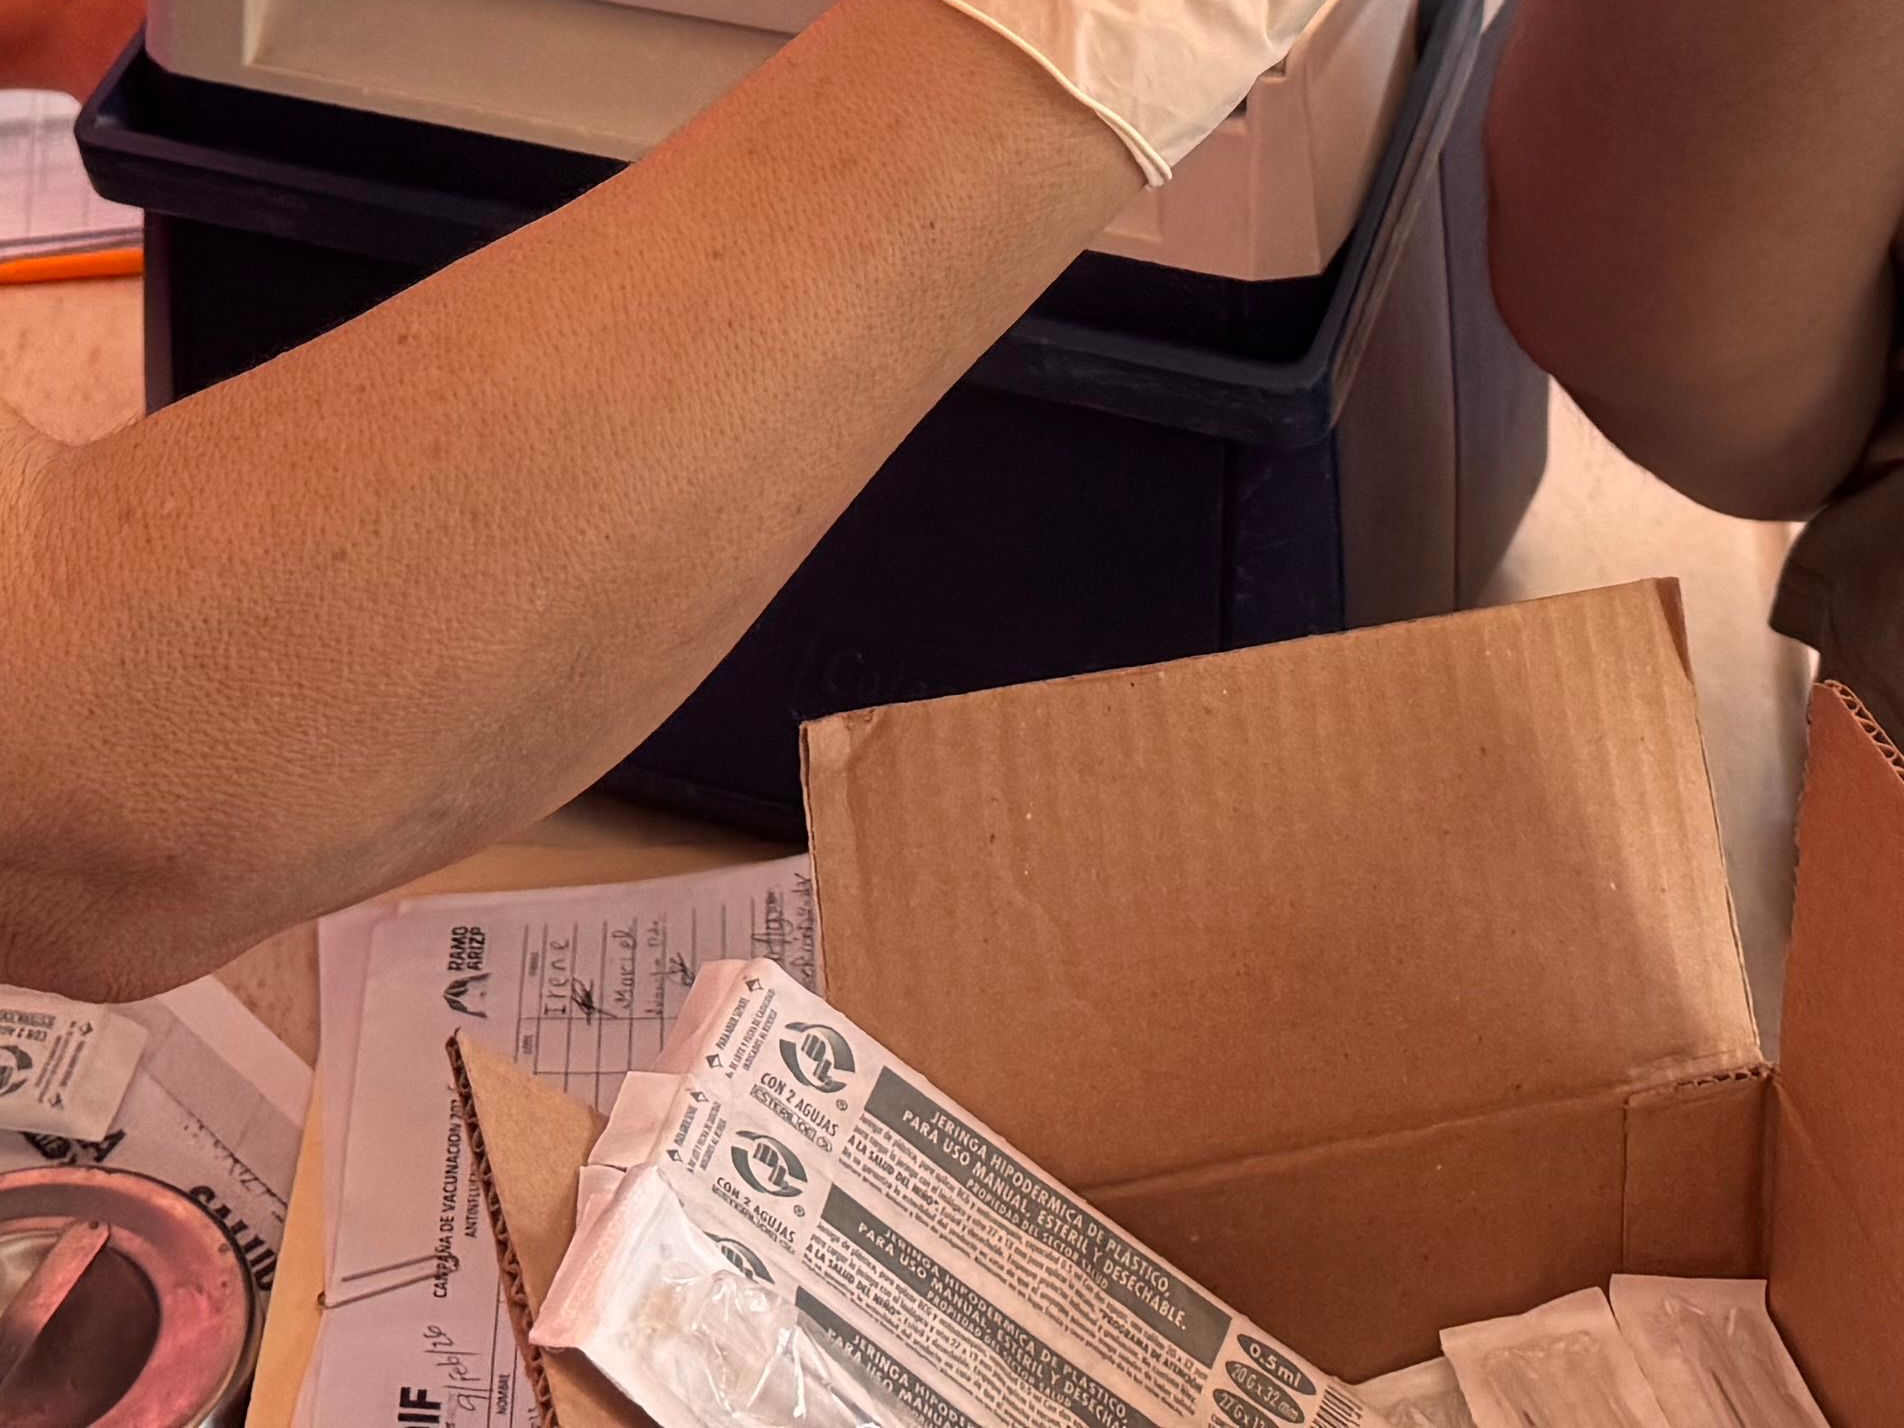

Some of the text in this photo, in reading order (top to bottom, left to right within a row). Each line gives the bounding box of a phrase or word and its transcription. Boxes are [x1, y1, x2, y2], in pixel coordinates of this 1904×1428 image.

[542, 937, 570, 1016] Irene
[760, 1070, 838, 1138] CON 2 AGUJAS
[440, 1122, 462, 1213] VACUNACION
[931, 1109, 989, 1160] JERINGA
[1086, 1222, 1106, 1244] DE
[438, 1215, 454, 1233] DE
[715, 1175, 740, 1200] CON
[741, 1196, 751, 1208] 2
[751, 1203, 796, 1244] AGUJAS
[902, 1108, 941, 1144] PARA
[941, 1137, 971, 1167] USO
[972, 1159, 1035, 1218] MANUAL,
[1090, 1246, 1102, 1263] Y
[1102, 1257, 1189, 1331] DESECHABLE.
[1021, 1219, 1040, 1238] DEL
[856, 1221, 897, 1257] PARA
[898, 1252, 928, 1280] USO
[929, 1276, 993, 1336] MANUAL,
[1047, 1370, 1059, 1386] Y
[850, 1331, 910, 1390] JERINGA
[925, 1289, 982, 1339] PROPIEDAD
[1037, 1381, 1072, 1409] SALUD
[1040, 1348, 1060, 1370] DE
[1247, 1341, 1302, 1388] 0.5 ml
[1230, 1362, 1247, 1384] 20
[1245, 1373, 1256, 1390] G
[1263, 1386, 1280, 1407] 32
